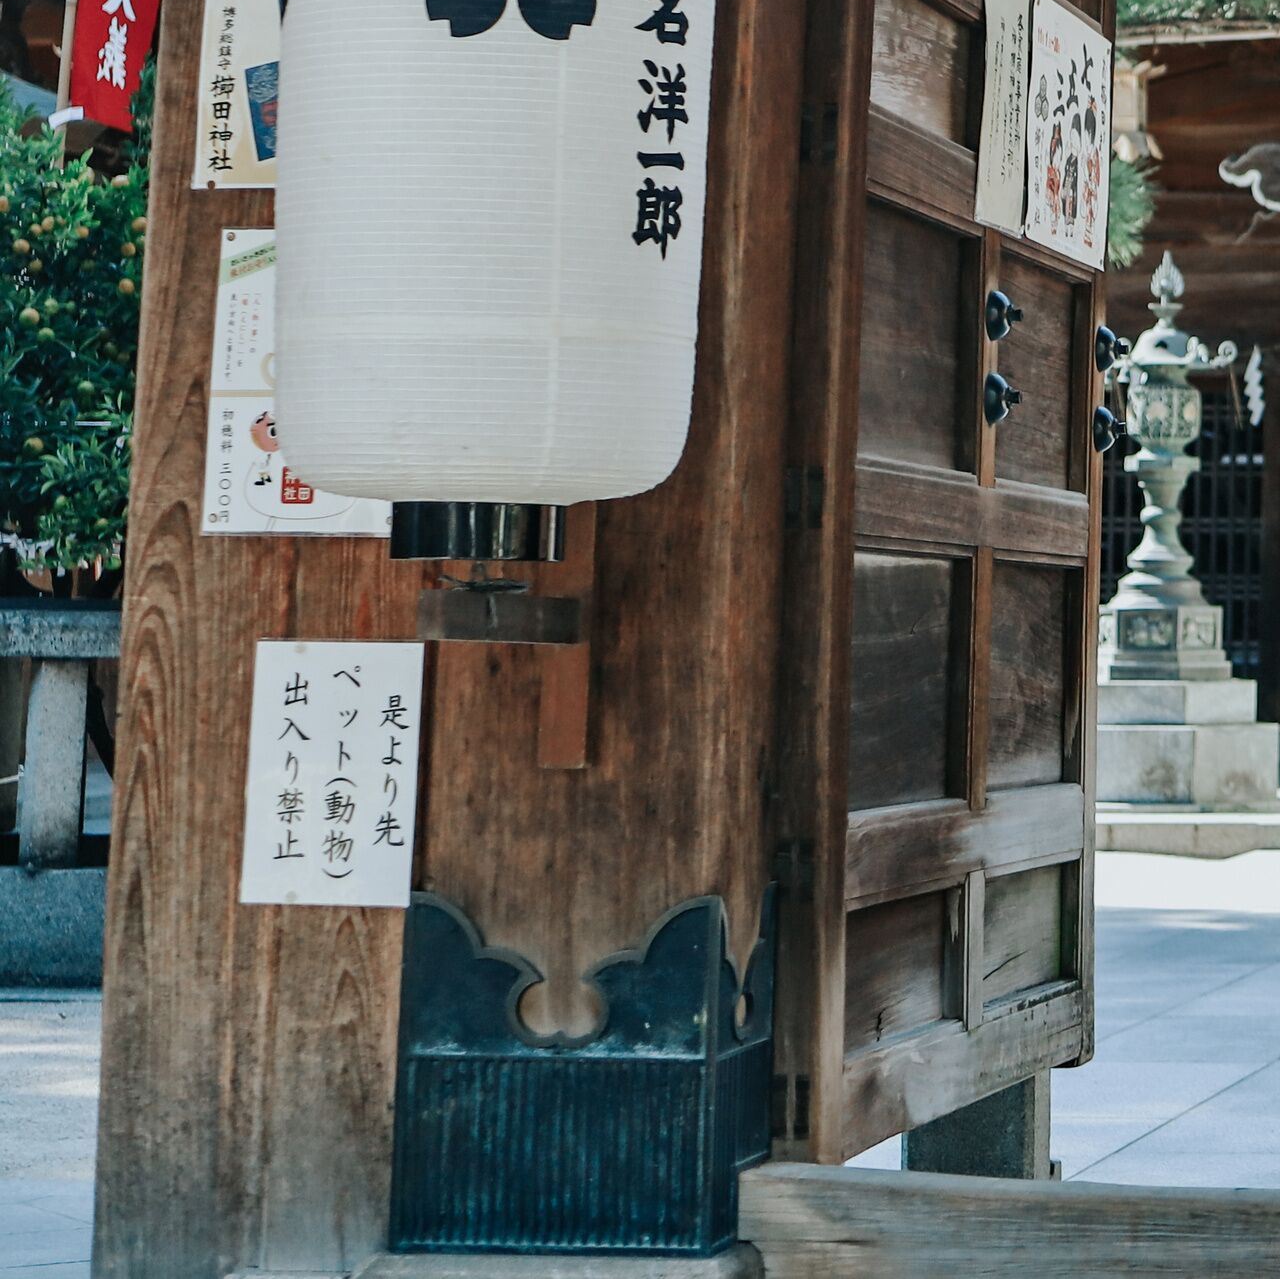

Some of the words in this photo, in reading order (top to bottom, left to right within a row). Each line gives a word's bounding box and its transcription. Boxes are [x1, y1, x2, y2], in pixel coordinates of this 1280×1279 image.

[273, 672, 311, 860] 出入り禁止
[373, 695, 409, 847] 是より先
